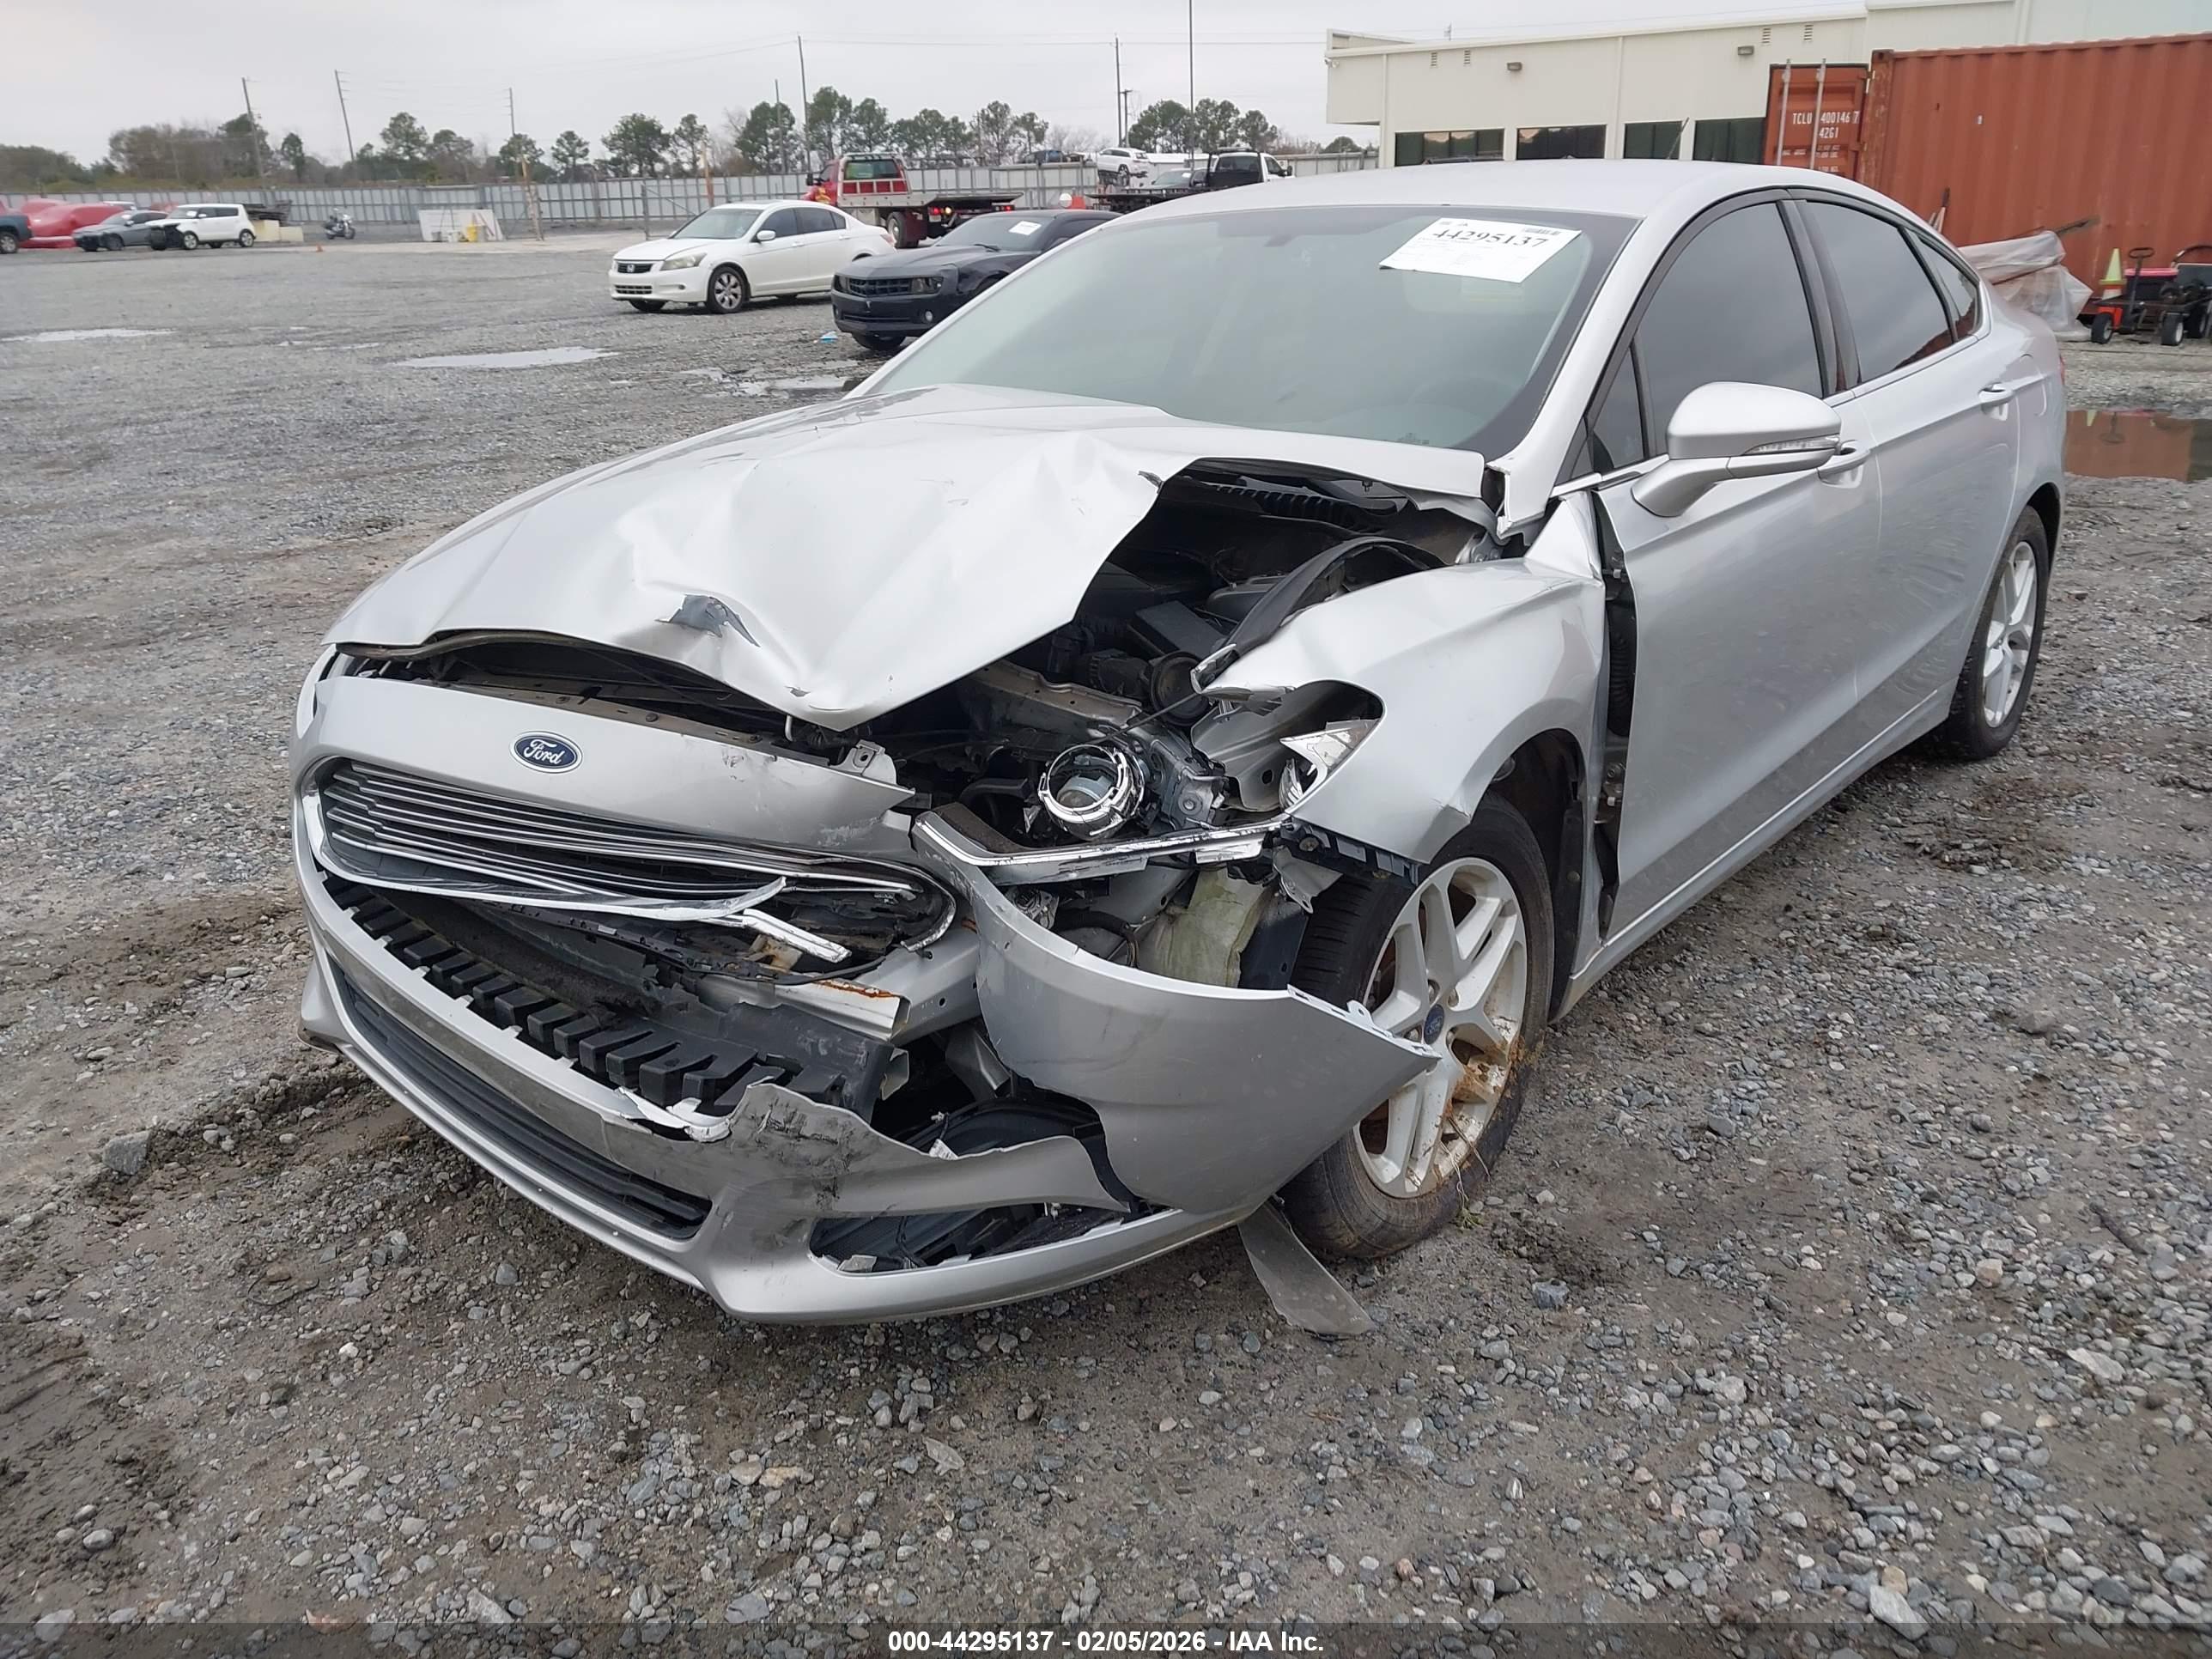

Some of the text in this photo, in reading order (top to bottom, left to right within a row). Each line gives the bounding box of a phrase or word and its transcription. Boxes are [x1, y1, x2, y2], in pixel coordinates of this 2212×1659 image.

[1792, 112, 1813, 125] TCLU
[1820, 112, 1850, 124] 400146
[1432, 228, 1549, 248] 44295137
[523, 738, 566, 765] Ford
